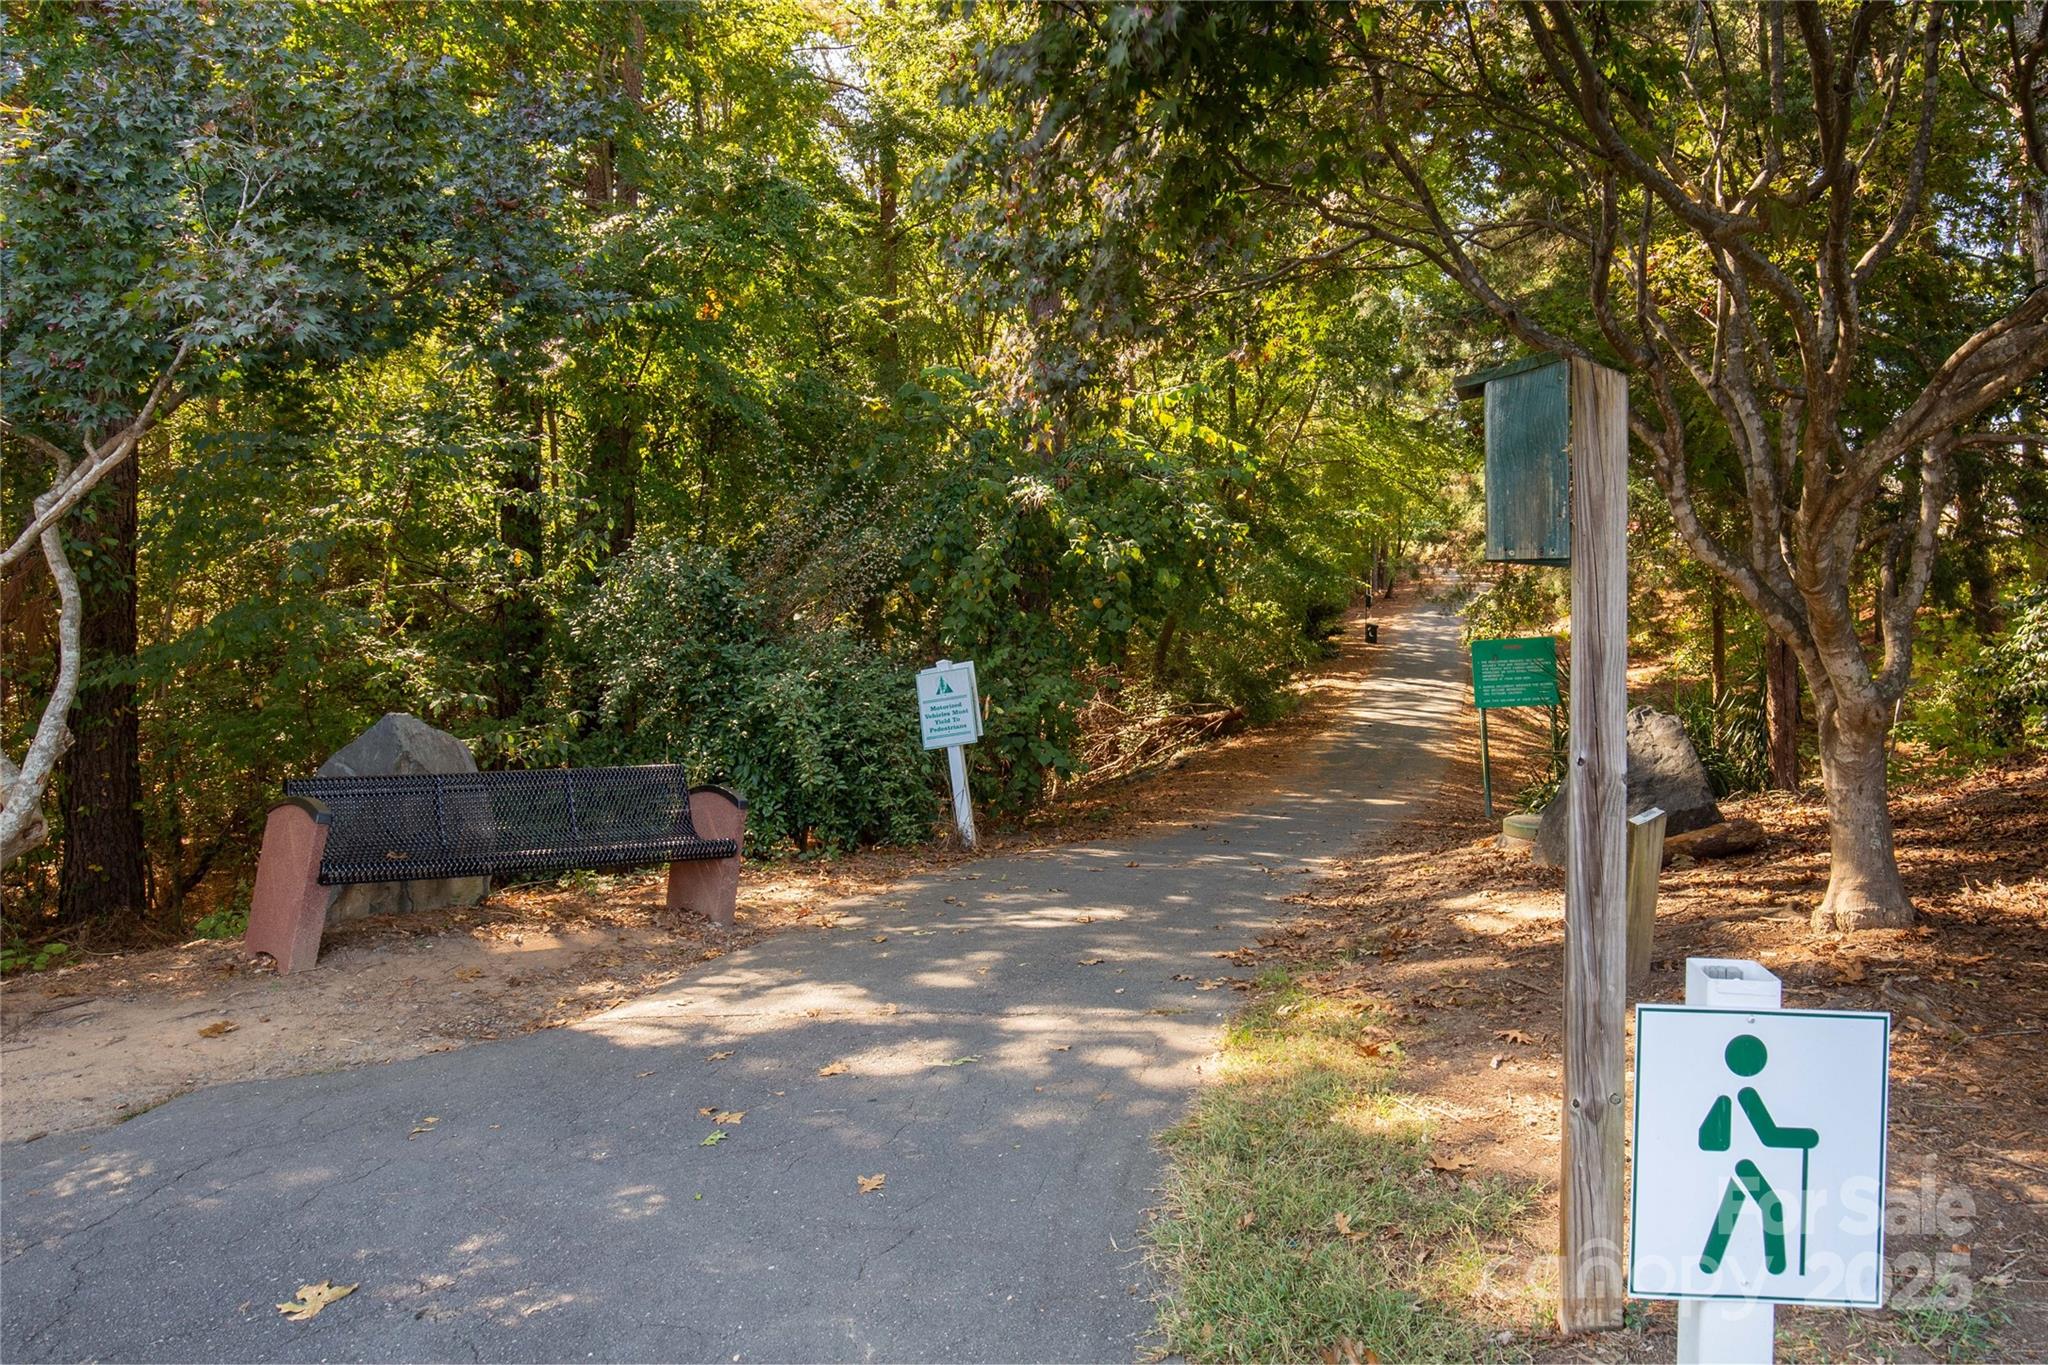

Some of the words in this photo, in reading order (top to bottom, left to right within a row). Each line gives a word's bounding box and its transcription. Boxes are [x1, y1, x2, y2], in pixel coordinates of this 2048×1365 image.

[930, 702, 962, 711] Motorized
[925, 711, 951, 719] Vehicles
[929, 724, 967, 733] Pedestrians
